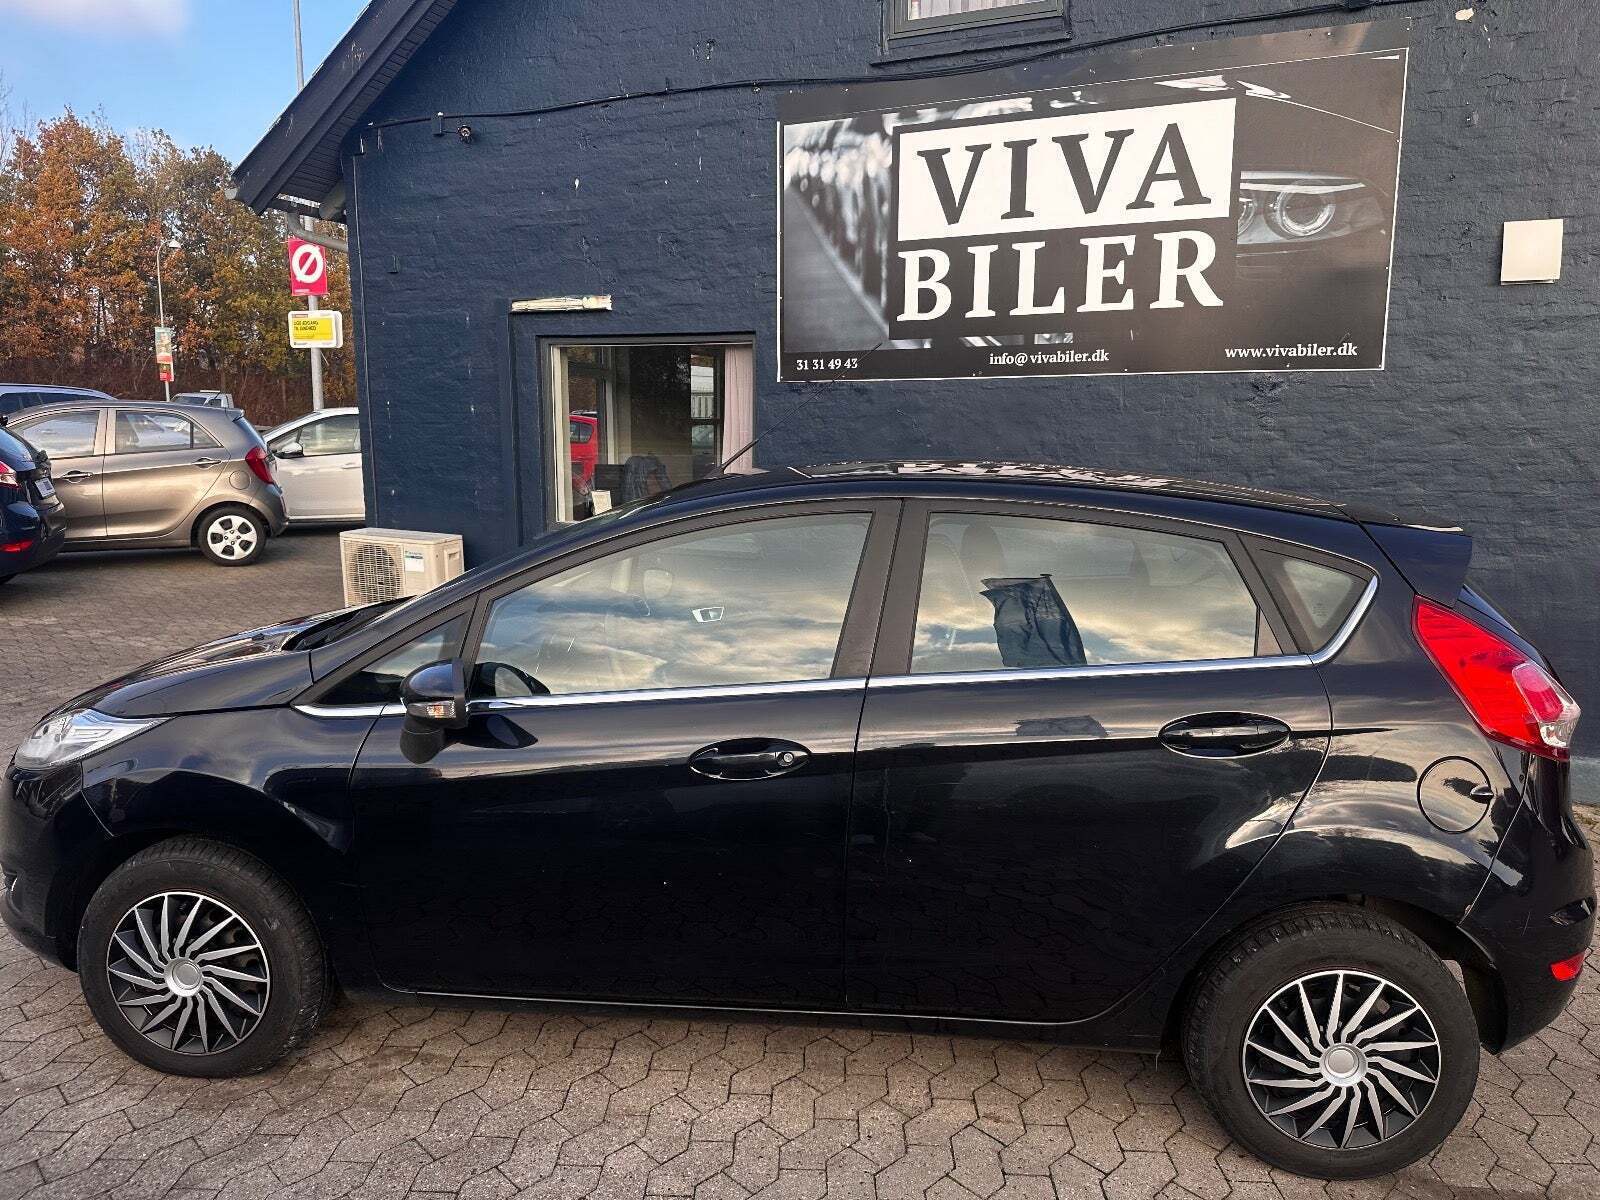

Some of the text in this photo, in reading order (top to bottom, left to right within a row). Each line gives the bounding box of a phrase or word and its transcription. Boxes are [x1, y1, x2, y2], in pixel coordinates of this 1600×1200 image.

[917, 123, 1211, 225] VIVA
[897, 230, 1224, 322] BILER
[989, 349, 1110, 367] info@vivabiler.dk
[1225, 342, 1358, 358] www.vivabiler.dk
[796, 357, 858, 371] 31 31 49 43
